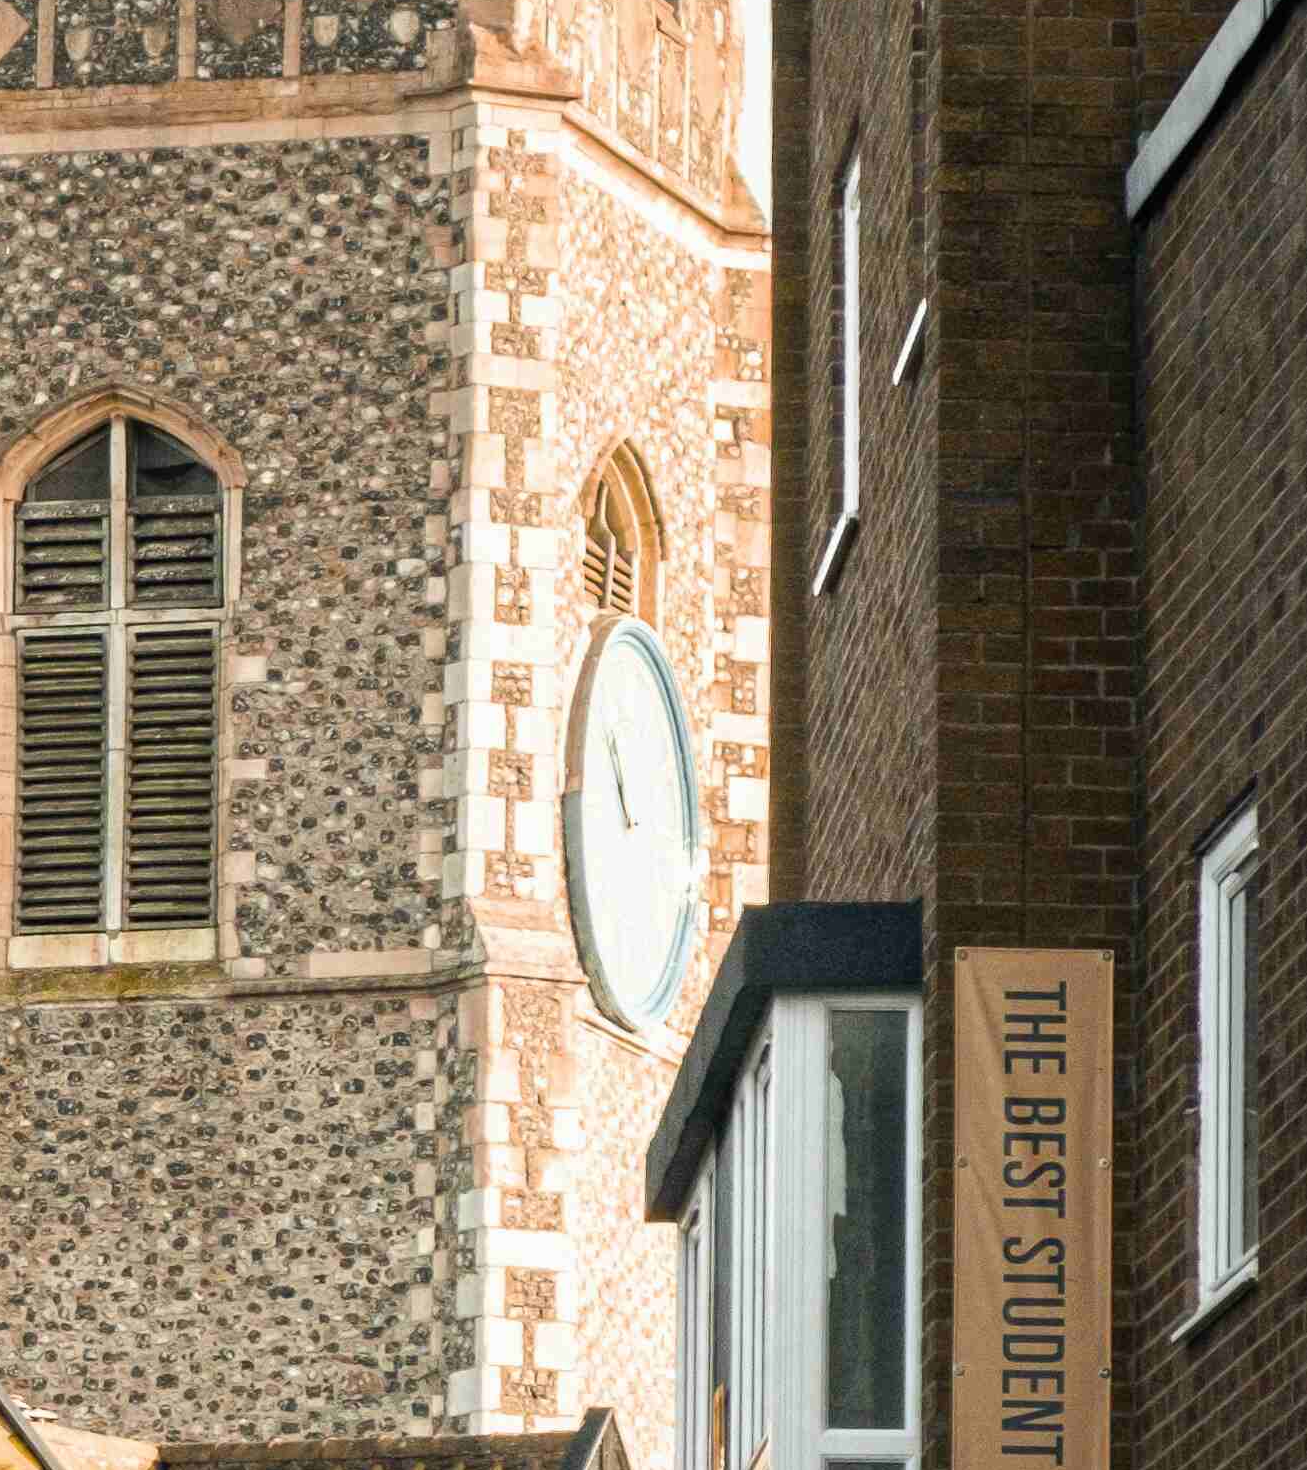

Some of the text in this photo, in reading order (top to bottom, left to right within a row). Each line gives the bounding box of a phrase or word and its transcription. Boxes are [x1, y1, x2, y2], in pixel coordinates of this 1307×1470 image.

[1003, 980, 1067, 1074] THE
[1002, 1097, 1066, 1219] BEST
[1001, 1236, 1065, 1467] STUDENT
